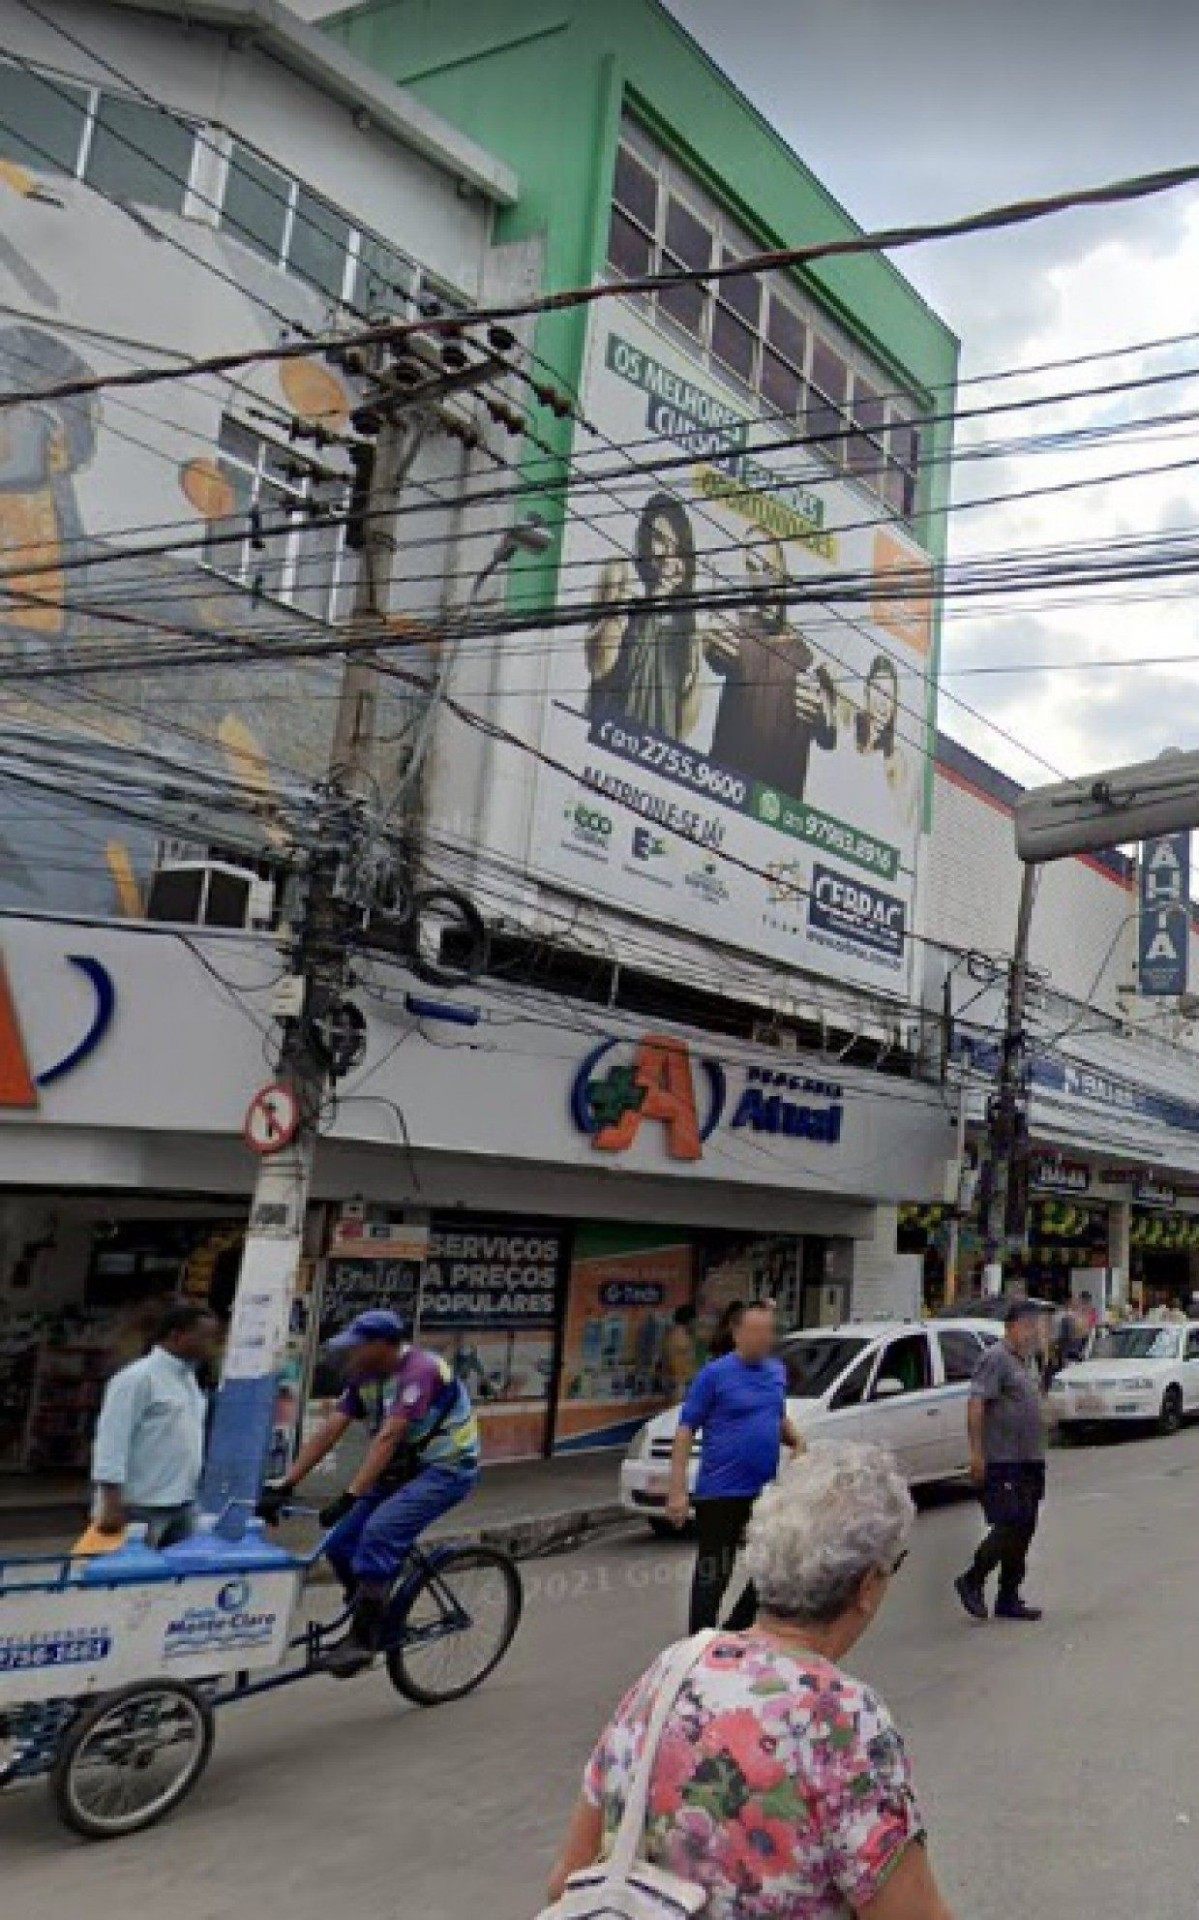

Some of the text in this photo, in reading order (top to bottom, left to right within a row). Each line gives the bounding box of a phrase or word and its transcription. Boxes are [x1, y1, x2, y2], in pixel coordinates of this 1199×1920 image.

[614, 344, 642, 380] OS
[731, 1089, 844, 1143] Atual
[429, 1232, 561, 1263] SERVIÇOS
[424, 1263, 556, 1291] A PREÇOS
[421, 1293, 555, 1313] POPULARES
